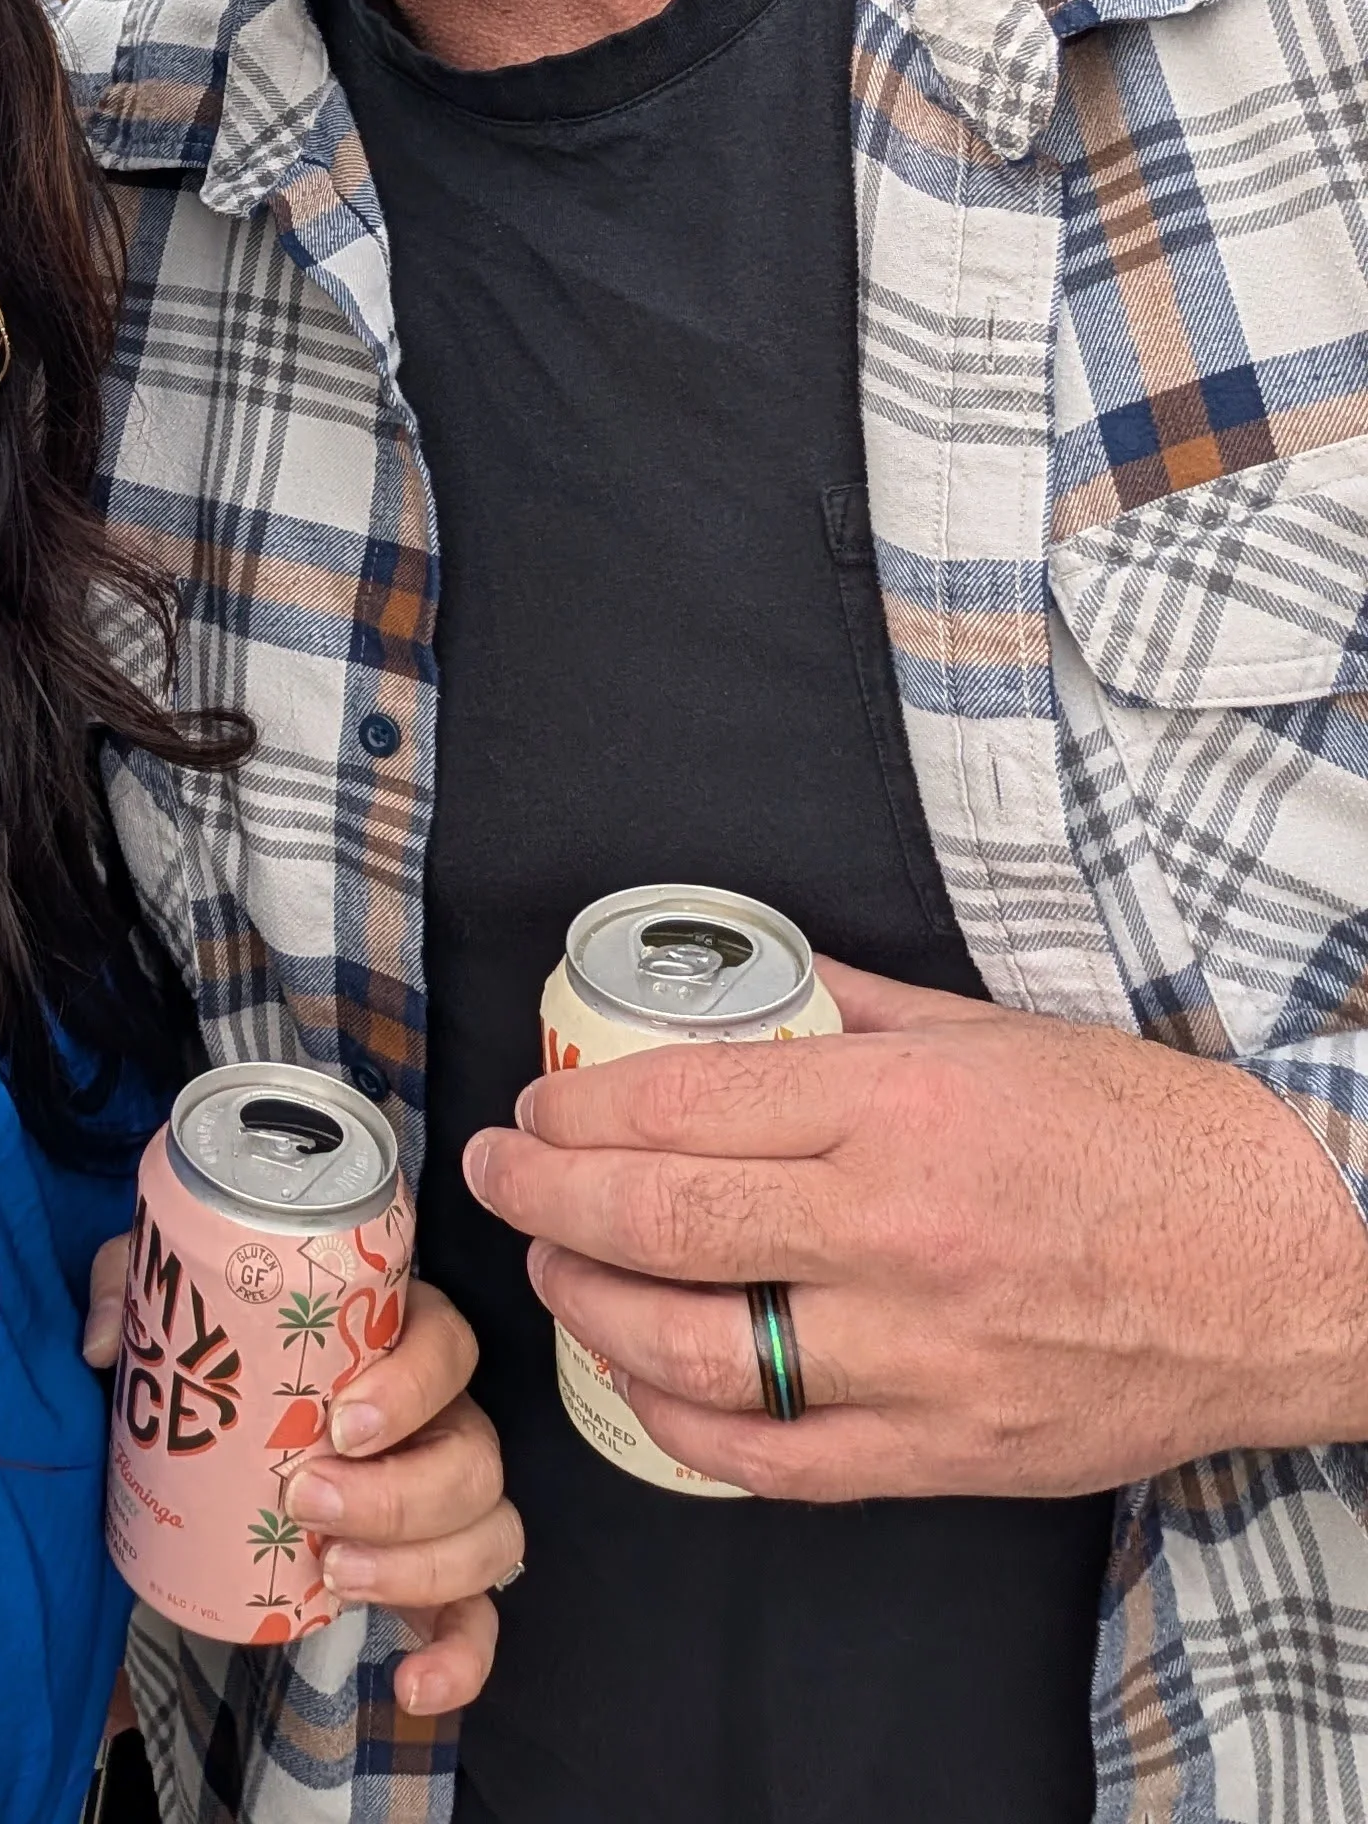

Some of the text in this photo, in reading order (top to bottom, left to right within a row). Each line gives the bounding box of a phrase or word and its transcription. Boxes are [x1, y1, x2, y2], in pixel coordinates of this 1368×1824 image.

[236, 1247, 278, 1271] GLUTEN
[241, 1264, 269, 1287] GF
[236, 1285, 268, 1301] FREE
